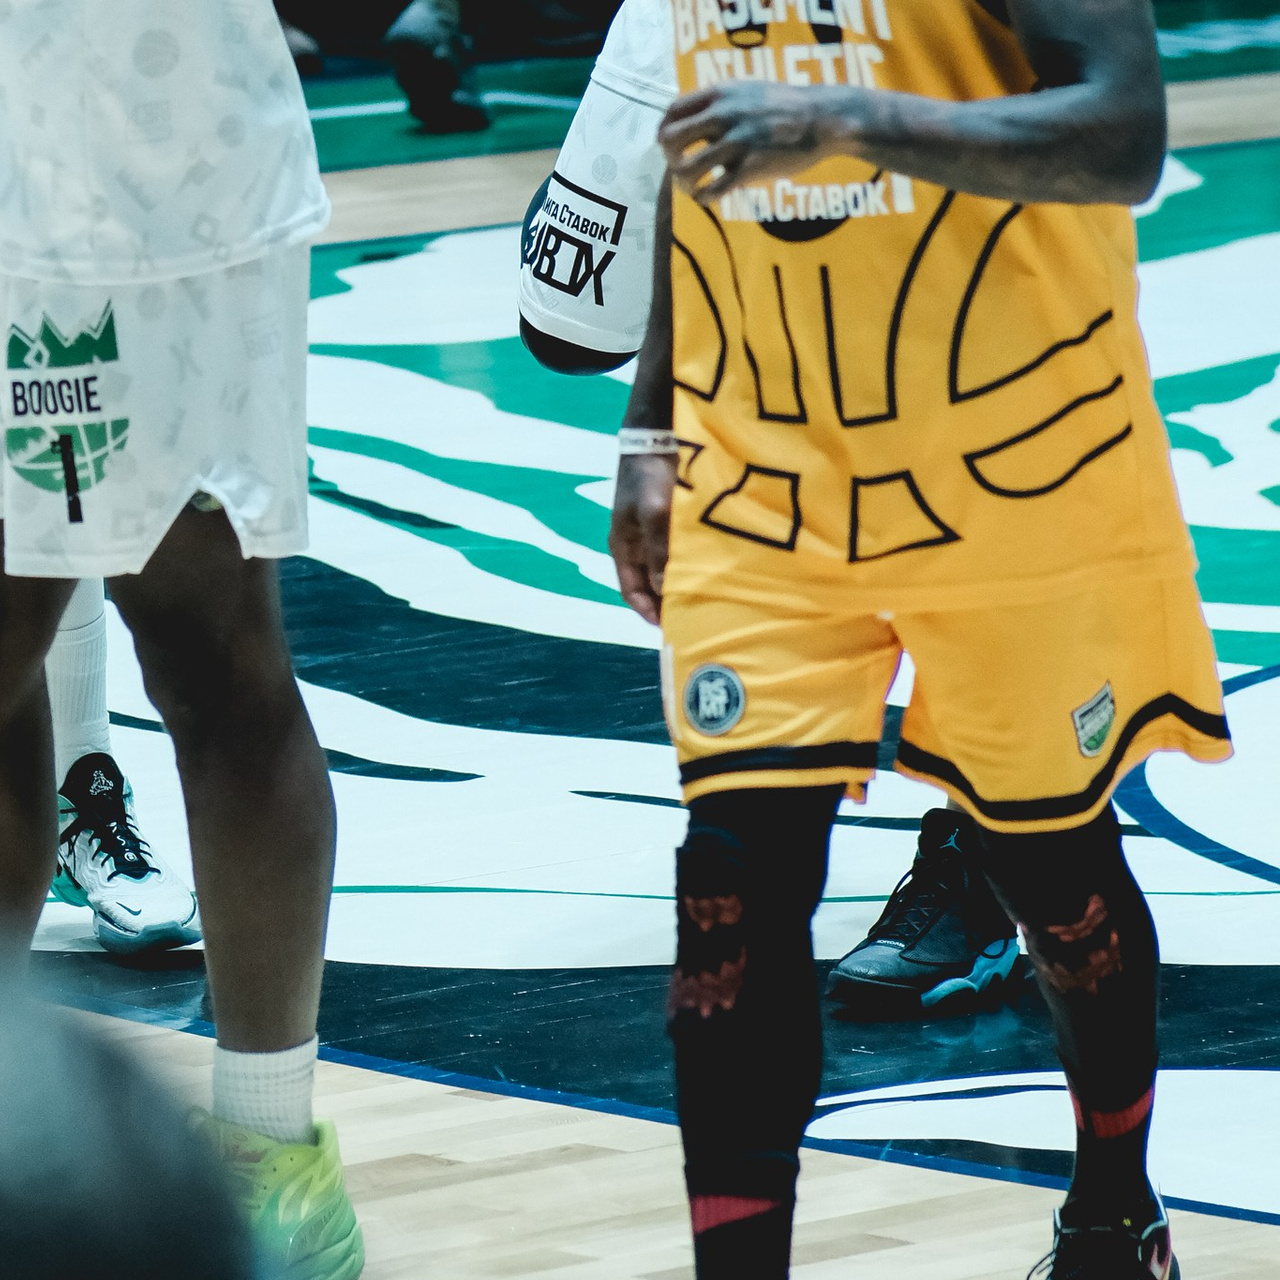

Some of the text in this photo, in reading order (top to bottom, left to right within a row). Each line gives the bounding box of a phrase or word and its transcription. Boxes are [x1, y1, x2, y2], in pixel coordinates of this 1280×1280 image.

[773, 178, 890, 222] СТАВОК
[559, 204, 611, 243] СТАВОК
[12, 376, 101, 415] BOOGIE
